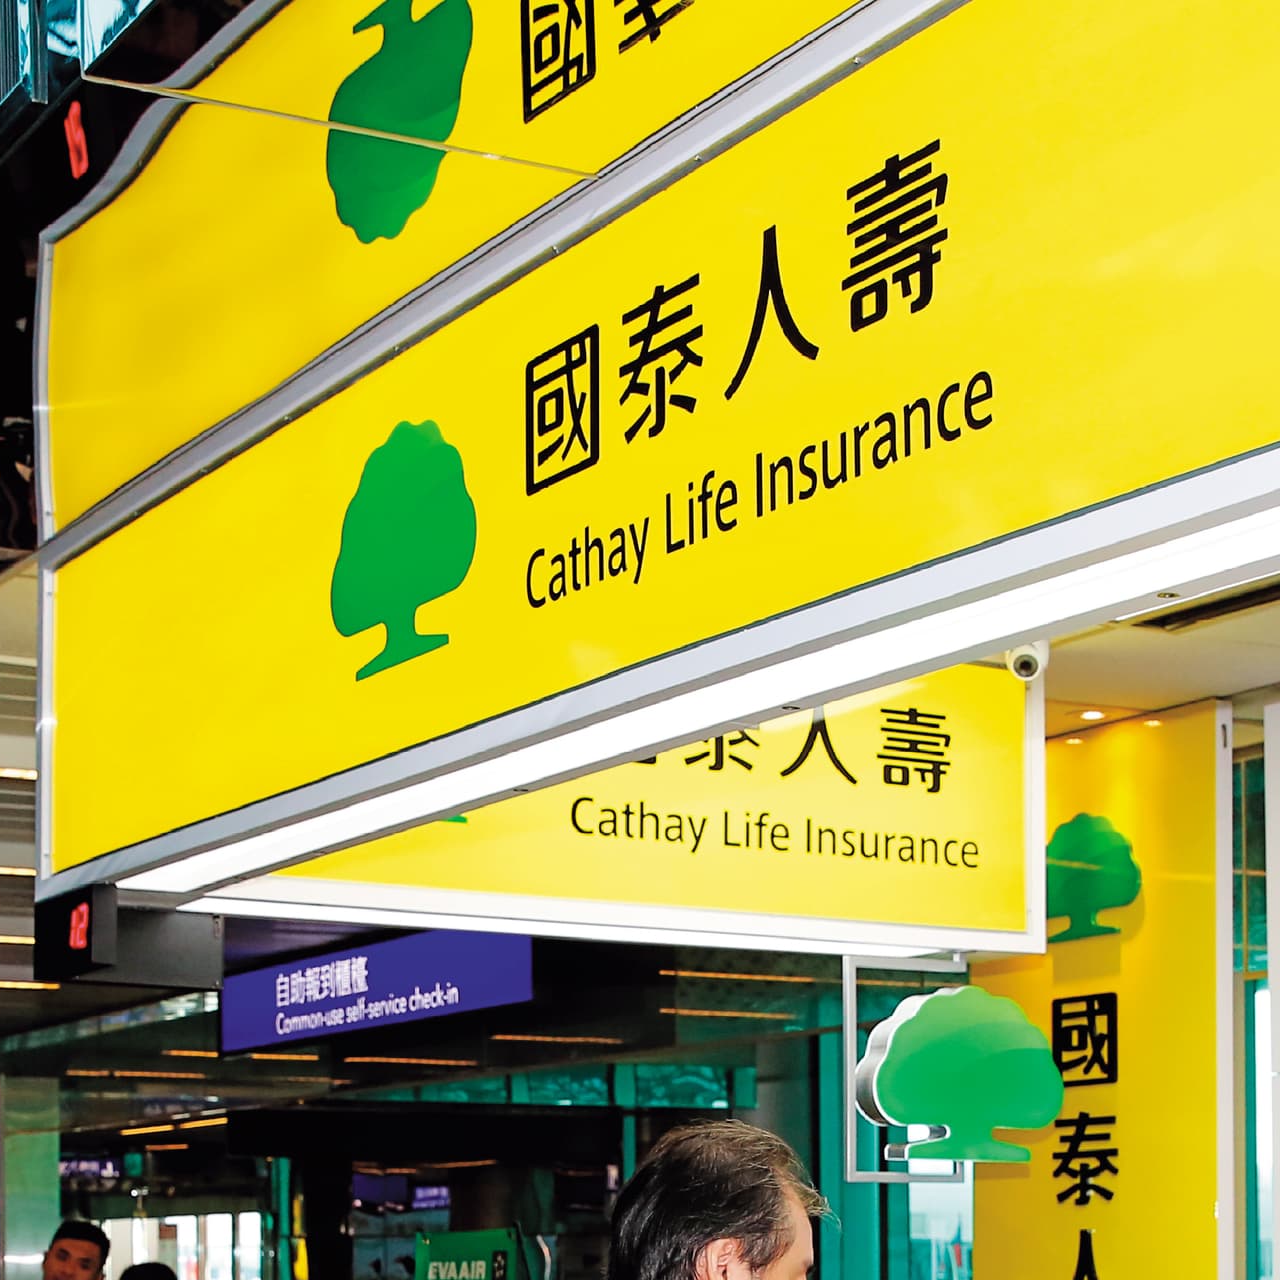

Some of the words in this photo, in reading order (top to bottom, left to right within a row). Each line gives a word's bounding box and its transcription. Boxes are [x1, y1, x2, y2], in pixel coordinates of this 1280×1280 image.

[525, 139, 949, 497] 國泰人壽
[526, 514, 651, 608] Cathay
[665, 472, 738, 554] Life
[756, 369, 994, 517] Insurance
[571, 796, 707, 854] Cathay
[723, 810, 790, 852] Life
[806, 818, 980, 869] Insurance
[275, 1008, 345, 1035] Common-use
[346, 994, 407, 1023] self-service
[408, 982, 459, 1011] check-in
